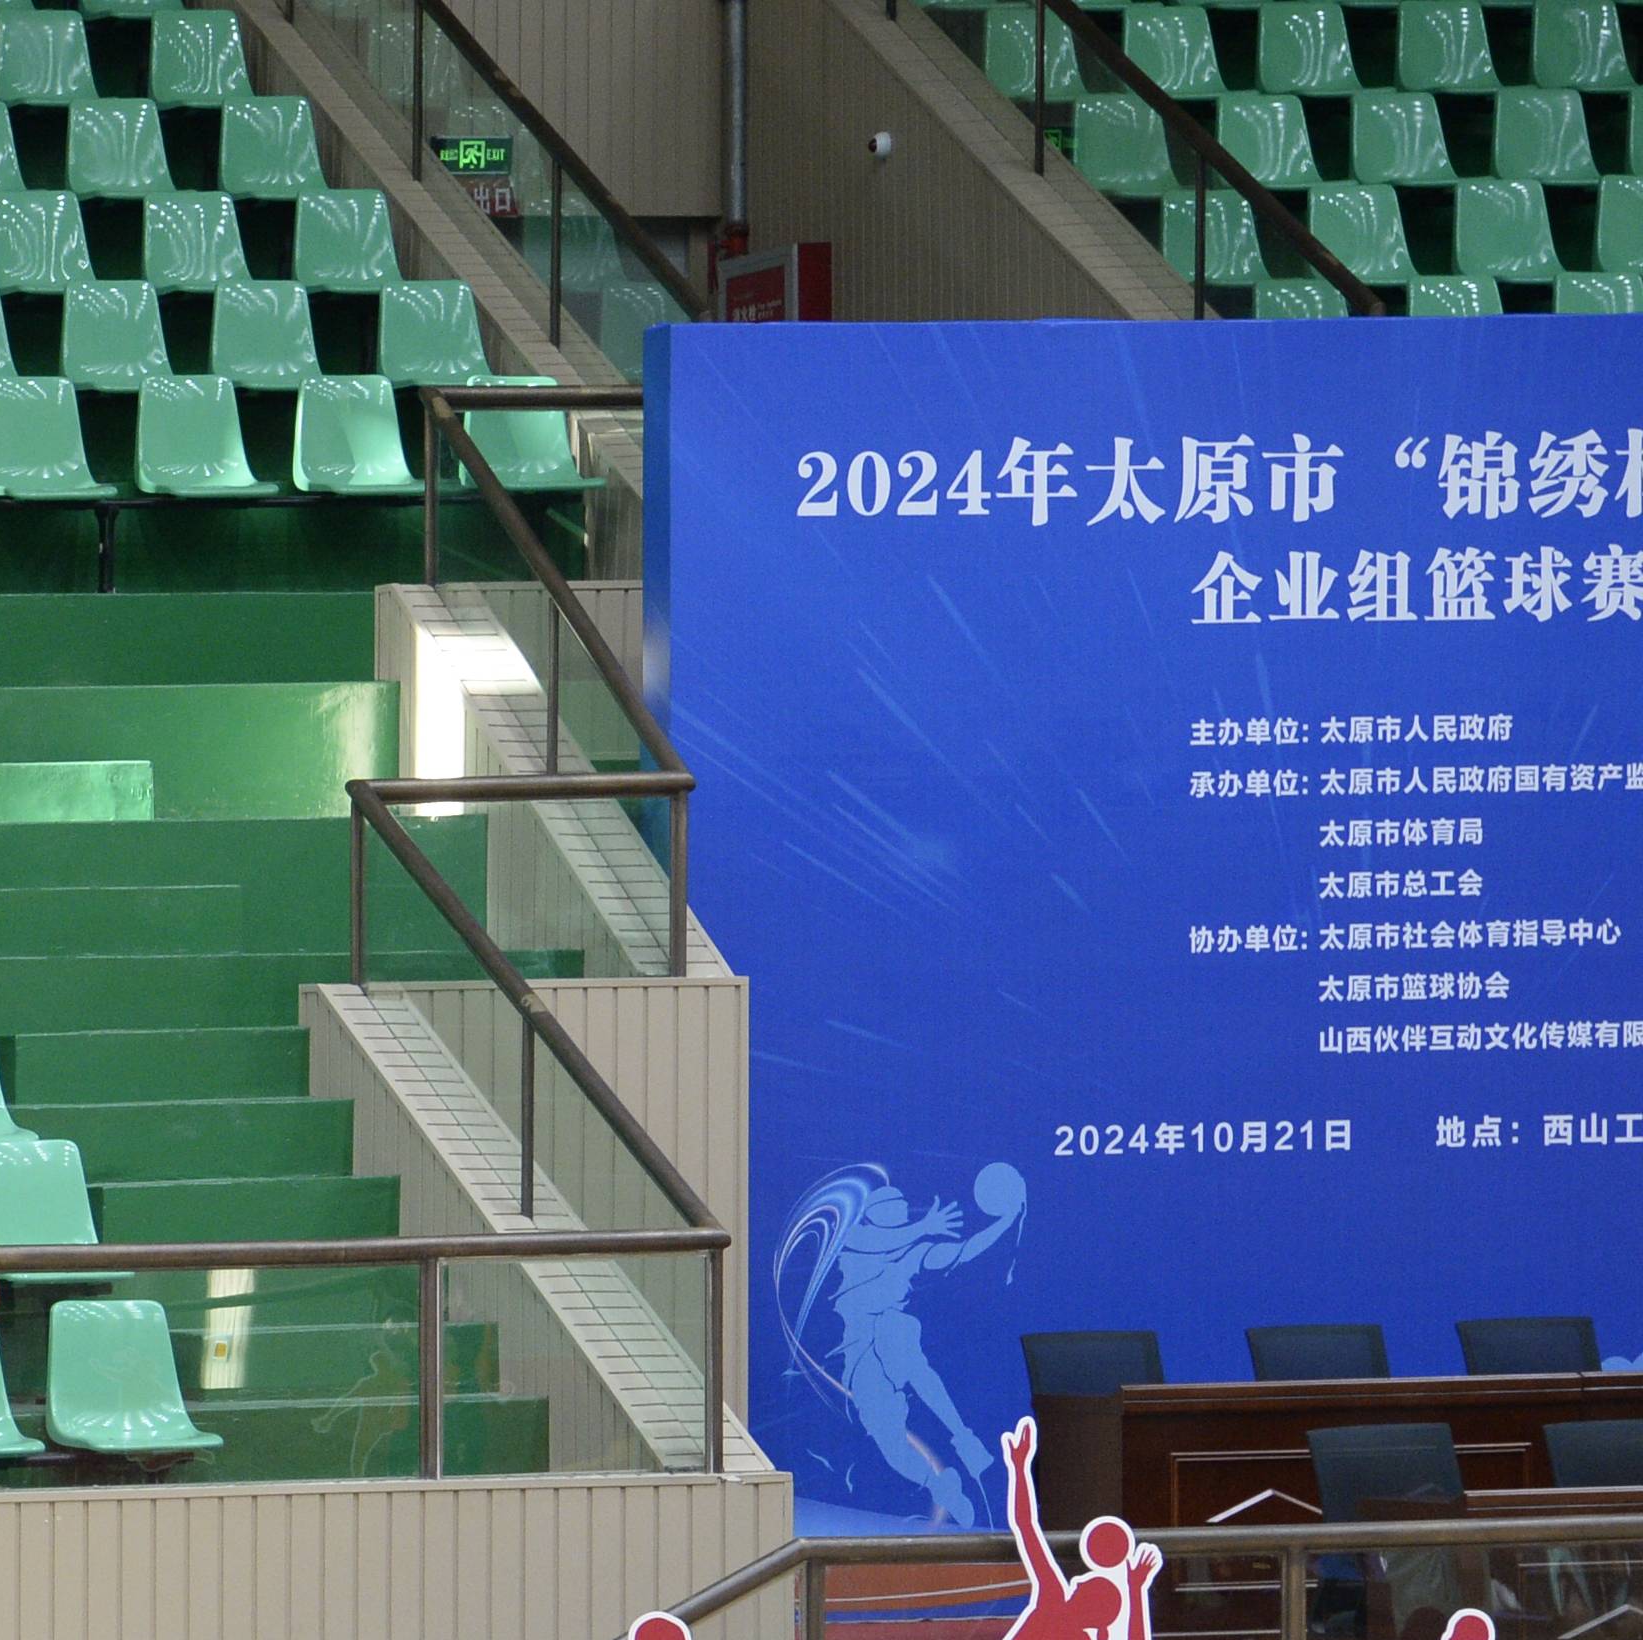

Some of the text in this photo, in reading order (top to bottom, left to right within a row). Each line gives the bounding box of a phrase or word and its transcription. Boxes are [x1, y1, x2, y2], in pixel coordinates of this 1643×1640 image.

[486, 148, 506, 161] EXIT
[1190, 543, 1643, 625] 企业组篮球赛
[1319, 817, 1484, 848] 太原市体育局
[1319, 868, 1484, 900] 太原市总工会
[1318, 970, 1511, 1003] 太原市篮球协会
[1318, 1019, 1643, 1054] 山西伙伴互动文化传媒有限
[1054, 1117, 1353, 1157] 2024年10月21日
